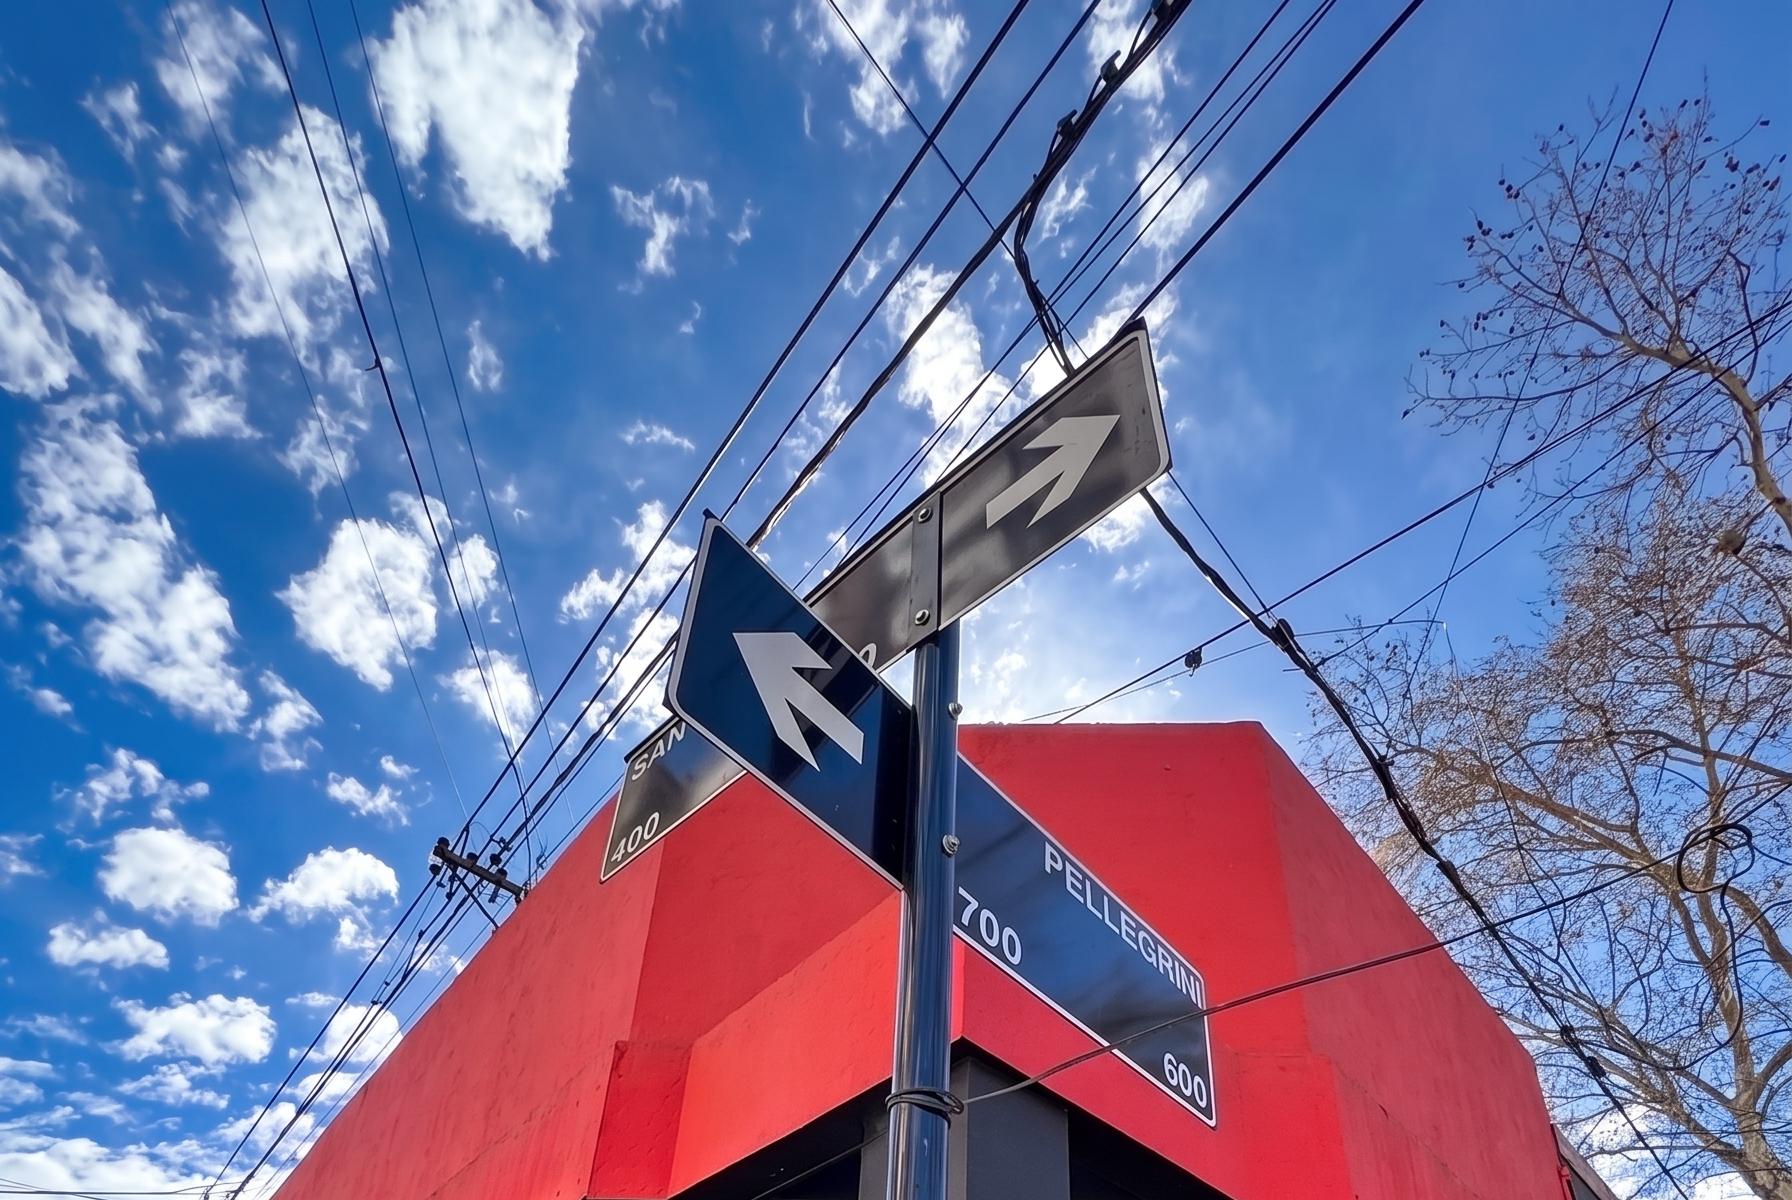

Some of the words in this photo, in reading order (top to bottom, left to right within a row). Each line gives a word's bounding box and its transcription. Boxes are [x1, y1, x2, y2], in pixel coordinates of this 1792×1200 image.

[631, 721, 686, 781] SAN
[611, 811, 660, 862] 400
[958, 886, 1022, 966] 700
[1044, 841, 1204, 1010] PELLEGRINI
[1163, 1052, 1207, 1109] 600
